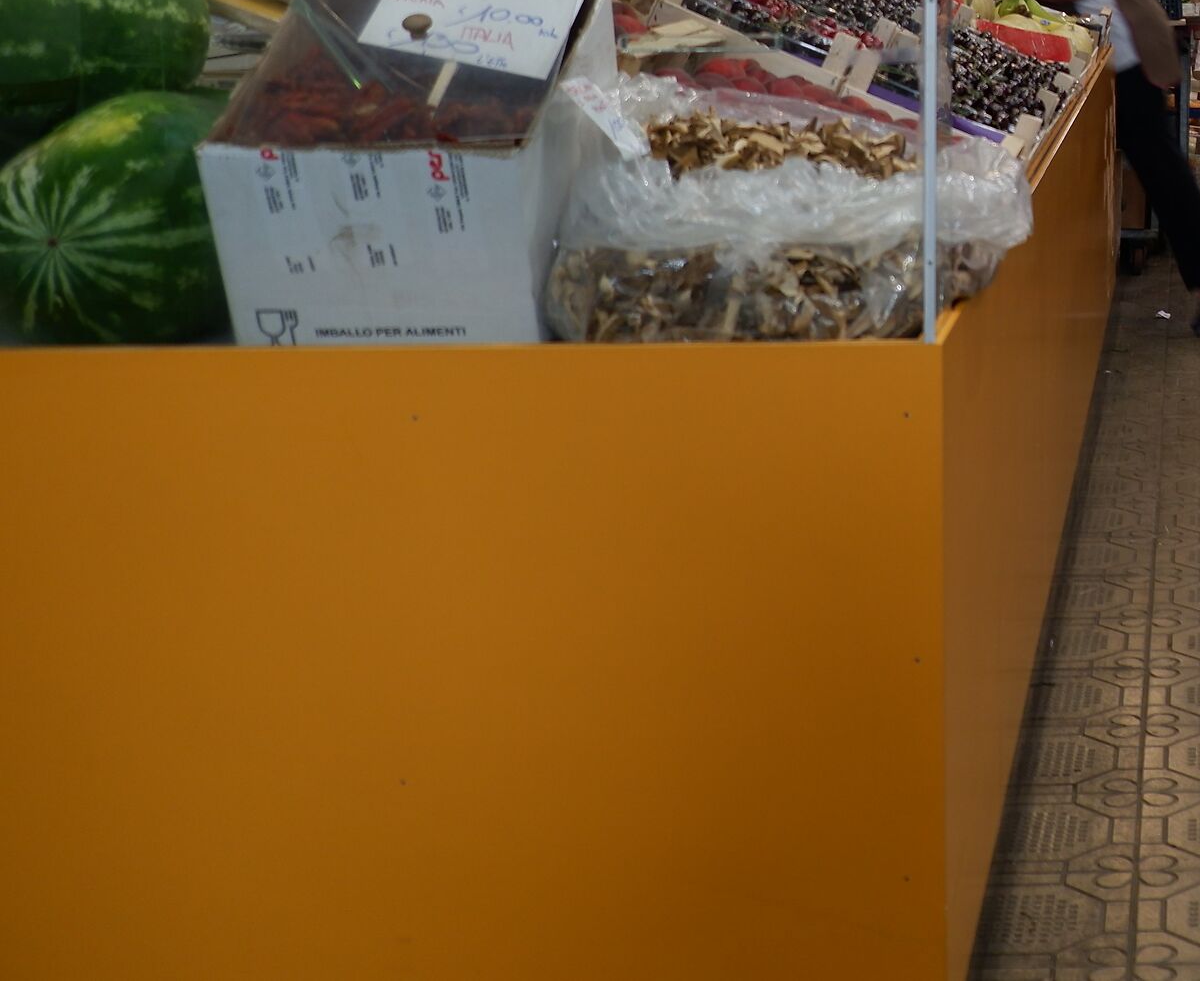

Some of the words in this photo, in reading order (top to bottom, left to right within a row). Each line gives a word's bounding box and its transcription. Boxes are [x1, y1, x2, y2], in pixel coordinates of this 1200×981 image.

[315, 327, 372, 338] IMBALLO
[375, 327, 401, 338] PER
[405, 326, 467, 338] ALIMENTI
